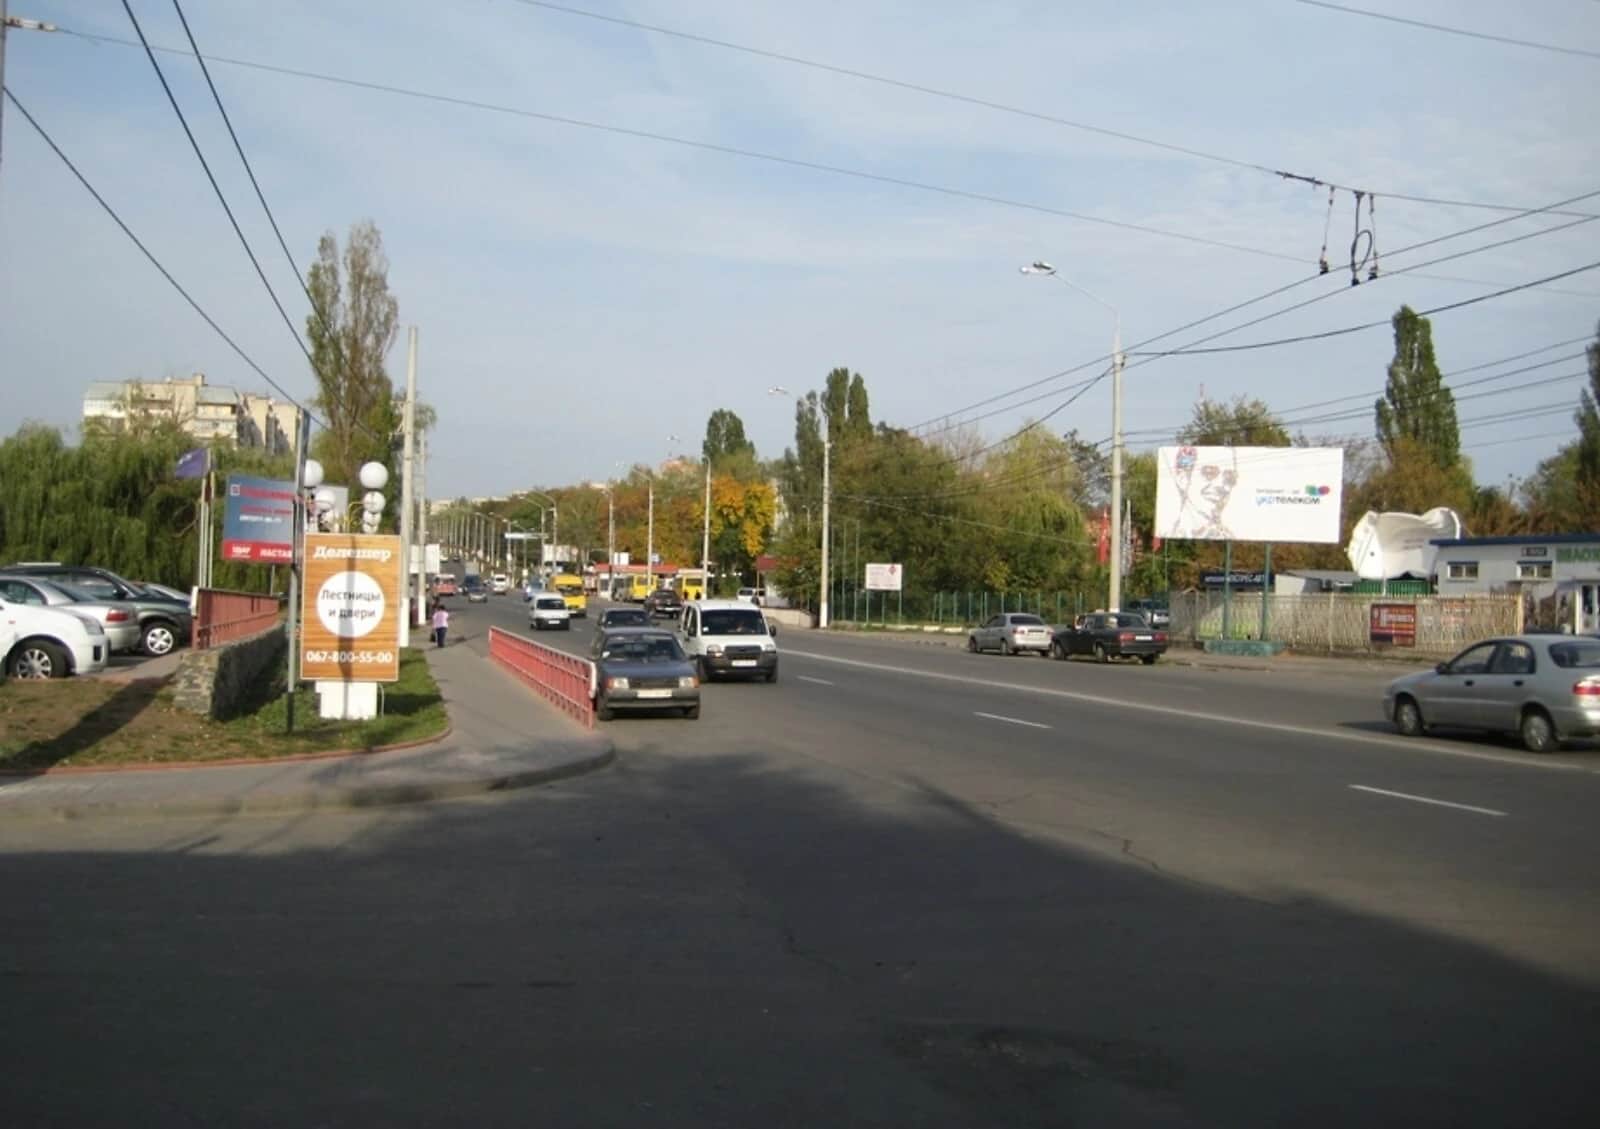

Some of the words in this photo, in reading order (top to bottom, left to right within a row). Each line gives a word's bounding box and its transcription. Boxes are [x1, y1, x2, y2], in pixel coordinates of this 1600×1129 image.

[321, 589, 381, 602] Лестницы
[328, 608, 336, 617] и
[339, 608, 376, 620] двери
